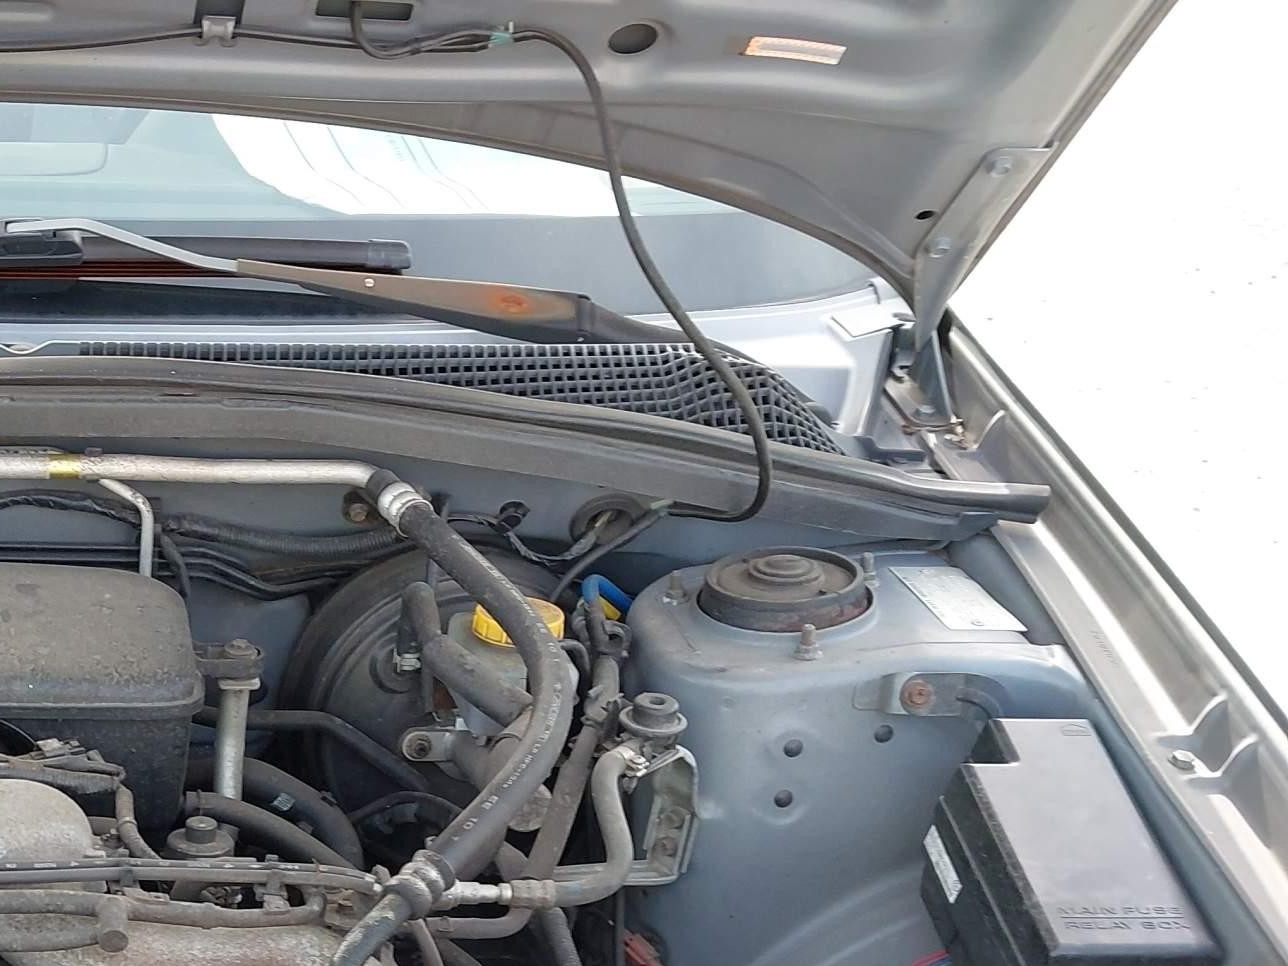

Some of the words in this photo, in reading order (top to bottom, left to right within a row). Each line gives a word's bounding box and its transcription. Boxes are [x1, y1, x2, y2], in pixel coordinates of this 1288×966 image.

[1056, 905, 1117, 915] MAIN
[1122, 905, 1185, 916] FUSE
[1063, 920, 1132, 931] RELAY
[1141, 920, 1192, 931] BOX
